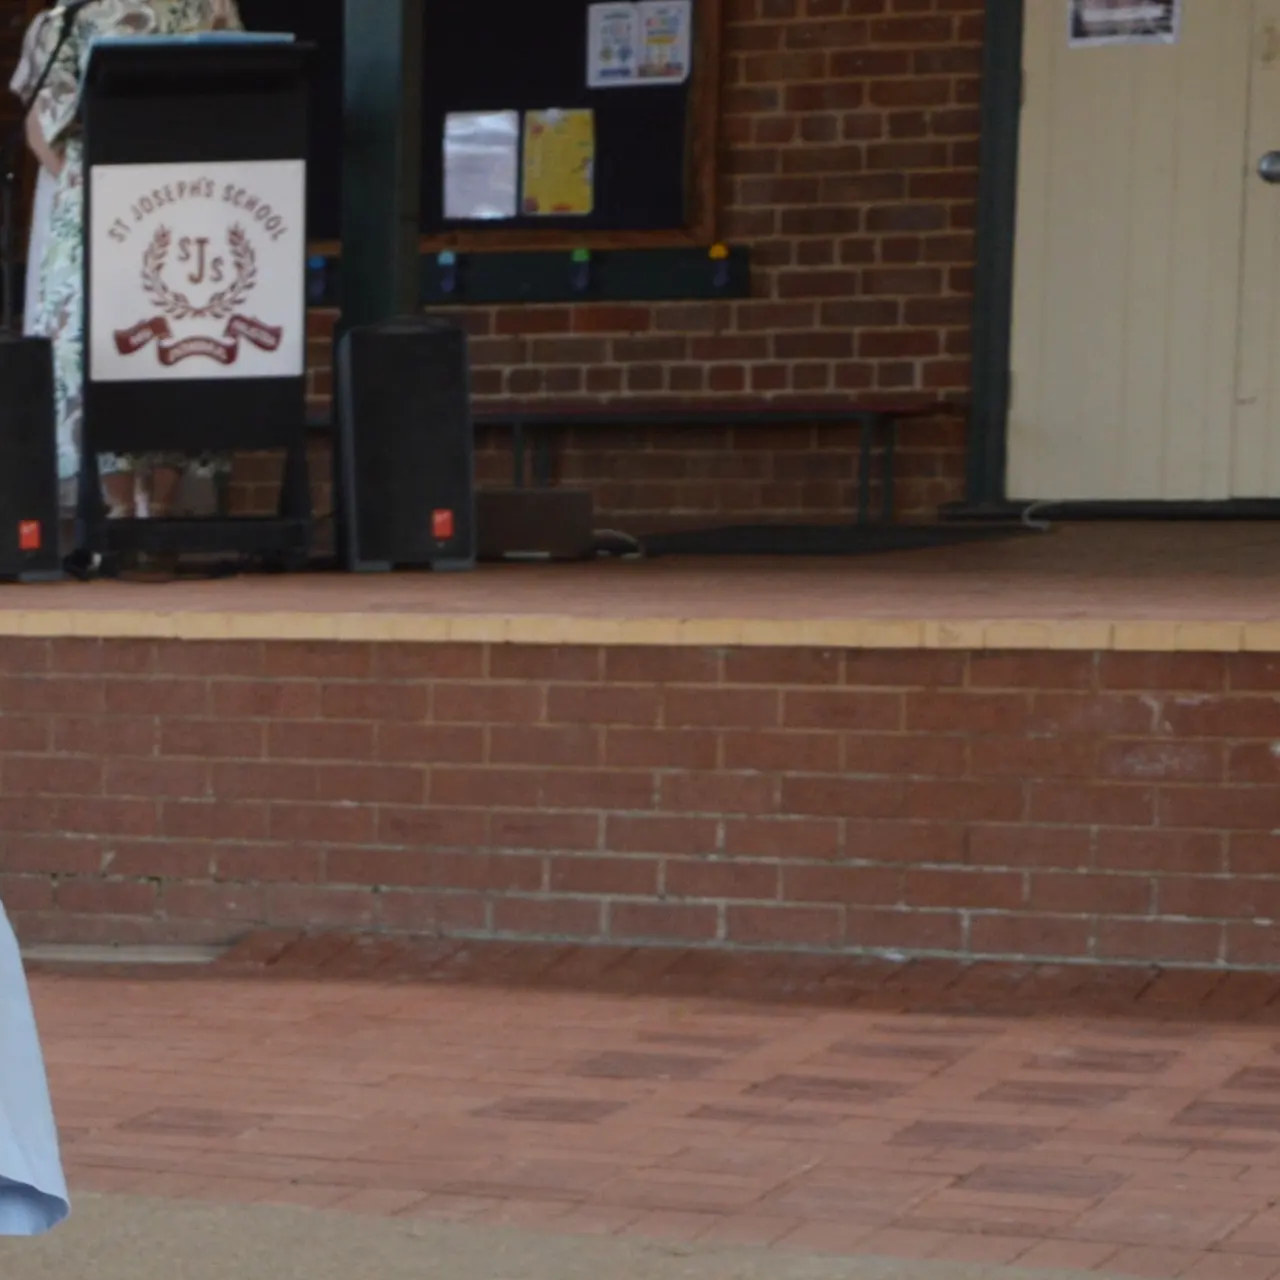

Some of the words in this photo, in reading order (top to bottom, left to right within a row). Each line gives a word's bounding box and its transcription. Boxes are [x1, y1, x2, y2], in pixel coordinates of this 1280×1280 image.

[108, 218, 132, 243] ST
[131, 176, 215, 221] JOSEPH'S
[221, 184, 288, 241] SCHOOL
